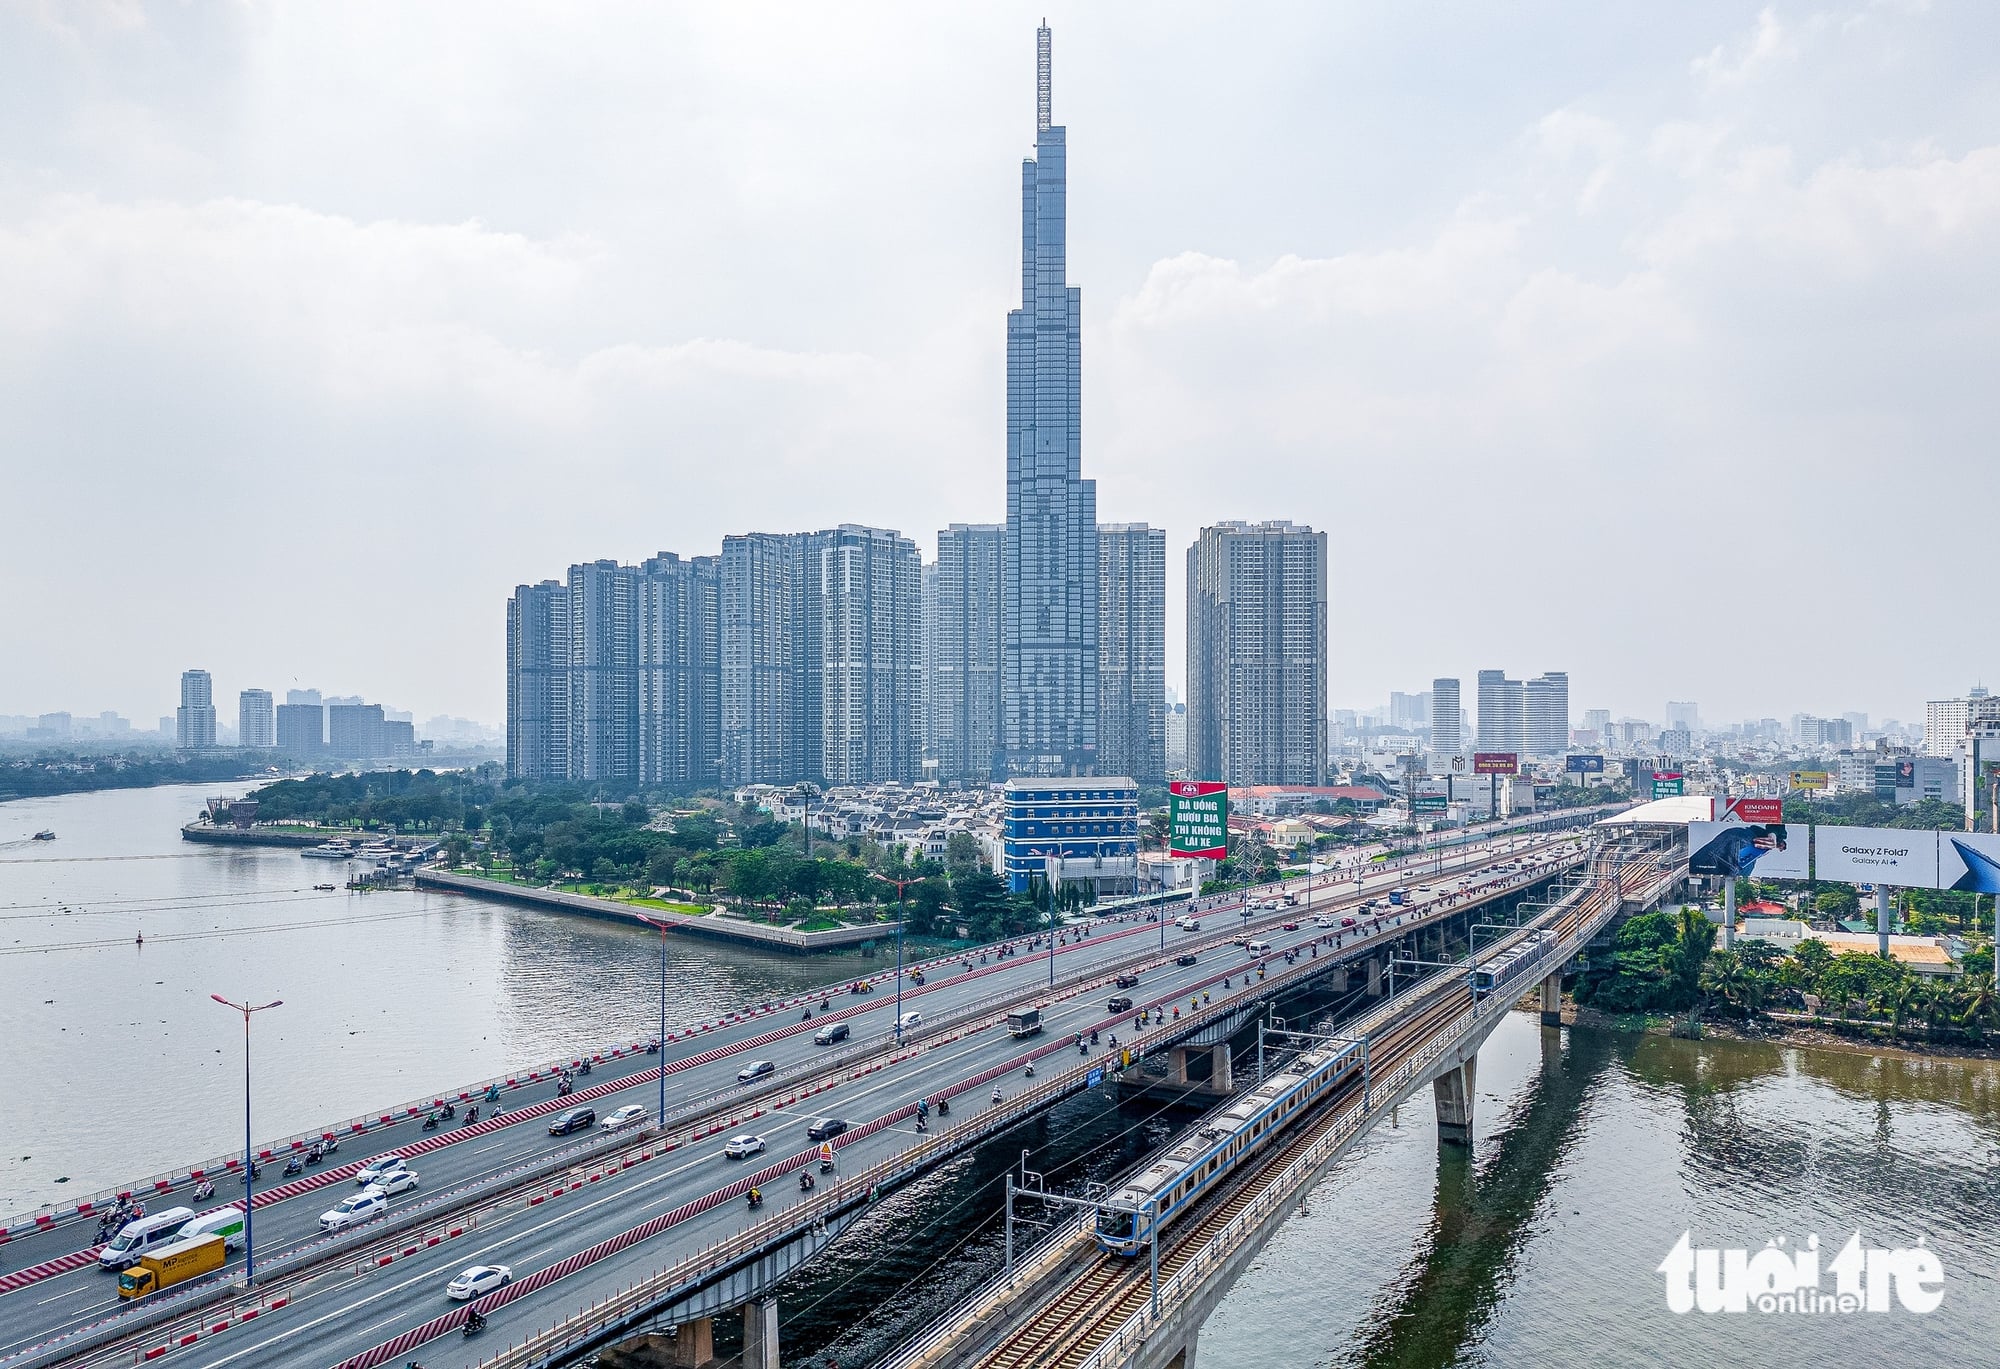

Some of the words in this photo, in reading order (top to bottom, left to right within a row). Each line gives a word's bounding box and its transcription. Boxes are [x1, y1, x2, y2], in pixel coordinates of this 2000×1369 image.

[1178, 799, 1190, 810] ĐÃ
[1193, 798, 1217, 811] UỐNG
[1176, 812, 1200, 824] RƯỢU
[1203, 813, 1219, 823] BIA
[1174, 823, 1189, 835] THÌ
[1191, 824, 1221, 836] KHÔNG
[1185, 836, 1198, 847] LÁI
[1200, 837, 1211, 847] XE
[1841, 845, 1876, 856] Galaxy
[1876, 847, 1882, 855] Z
[1883, 848, 1909, 856] Fold7
[1851, 857, 1880, 866] Galaxy
[163, 1257, 178, 1268] MP
